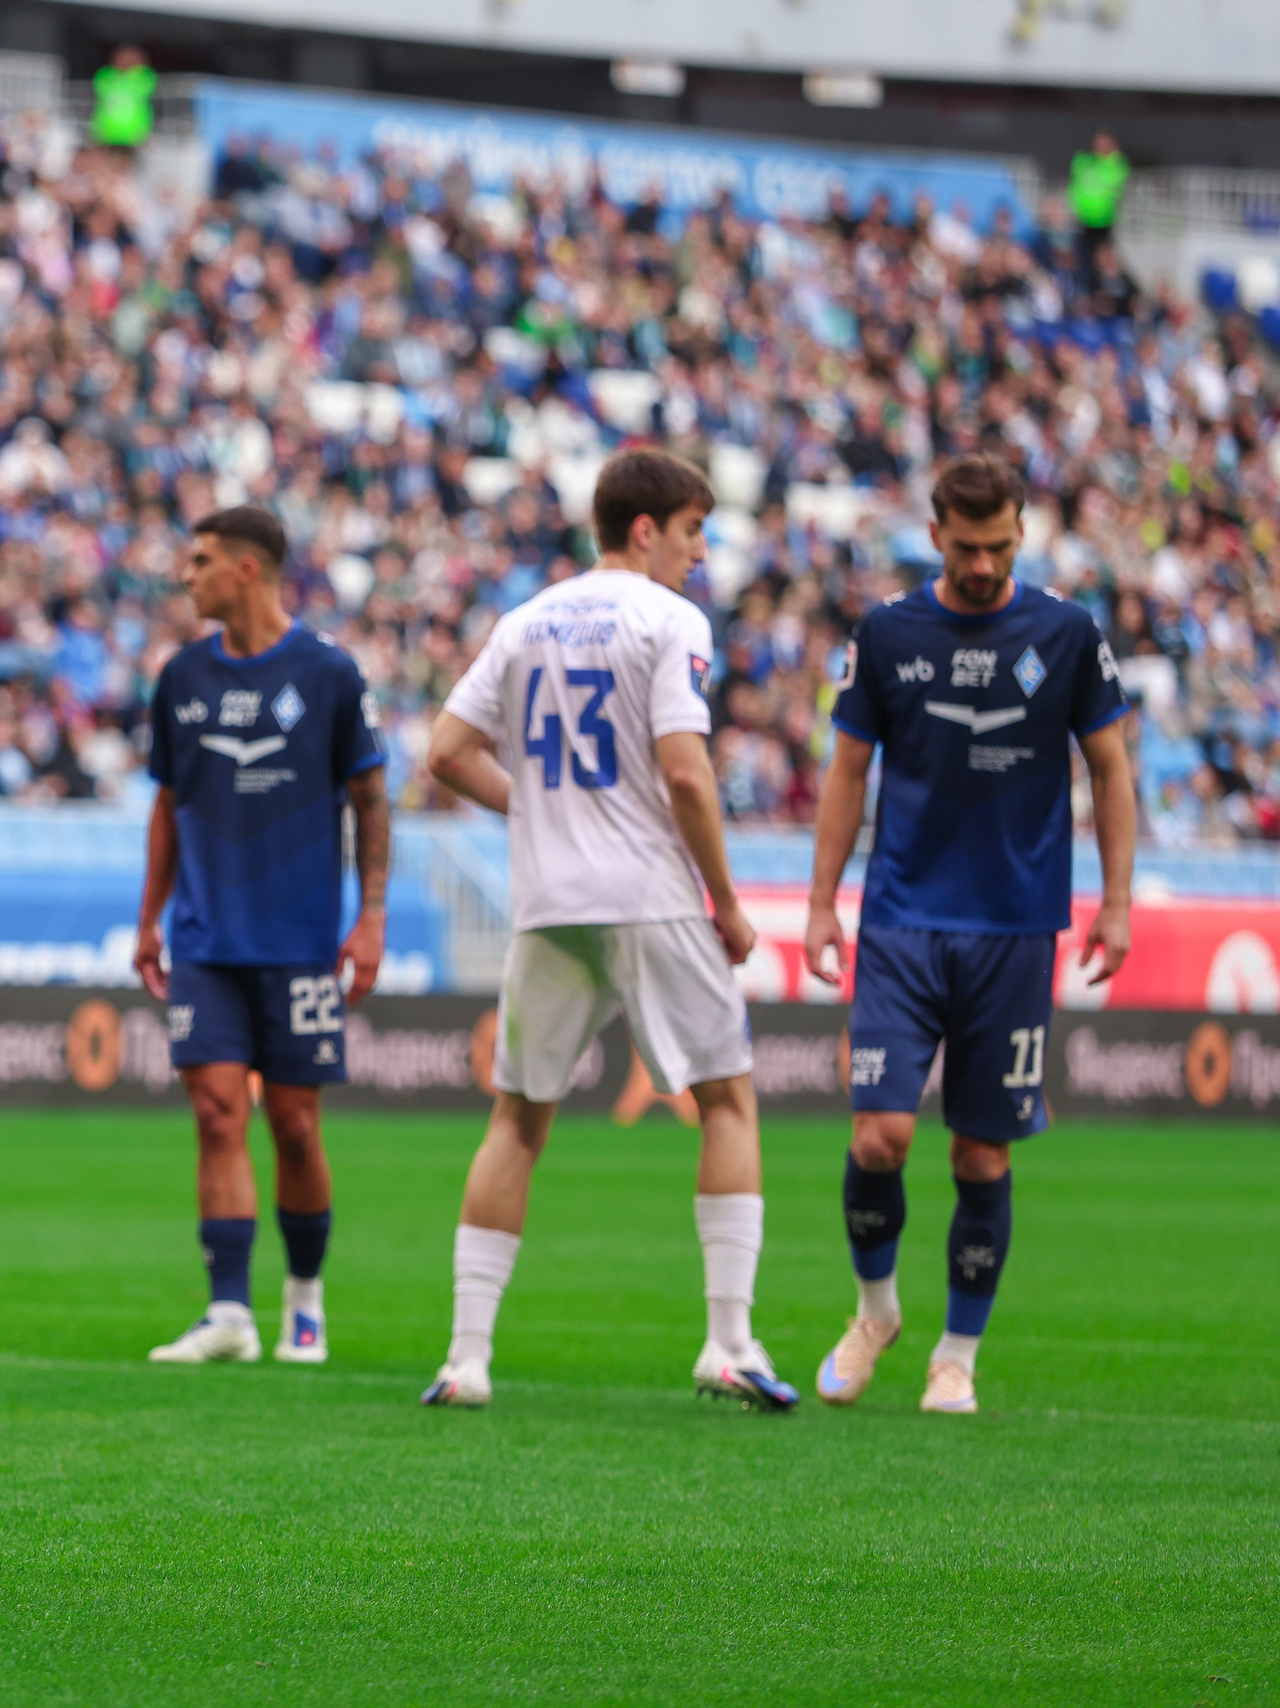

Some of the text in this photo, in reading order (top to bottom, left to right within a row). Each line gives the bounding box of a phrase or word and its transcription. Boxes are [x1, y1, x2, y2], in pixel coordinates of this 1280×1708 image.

[524, 666, 617, 789] 43
[288, 974, 343, 1036] 22
[1001, 1024, 1046, 1089] 11
